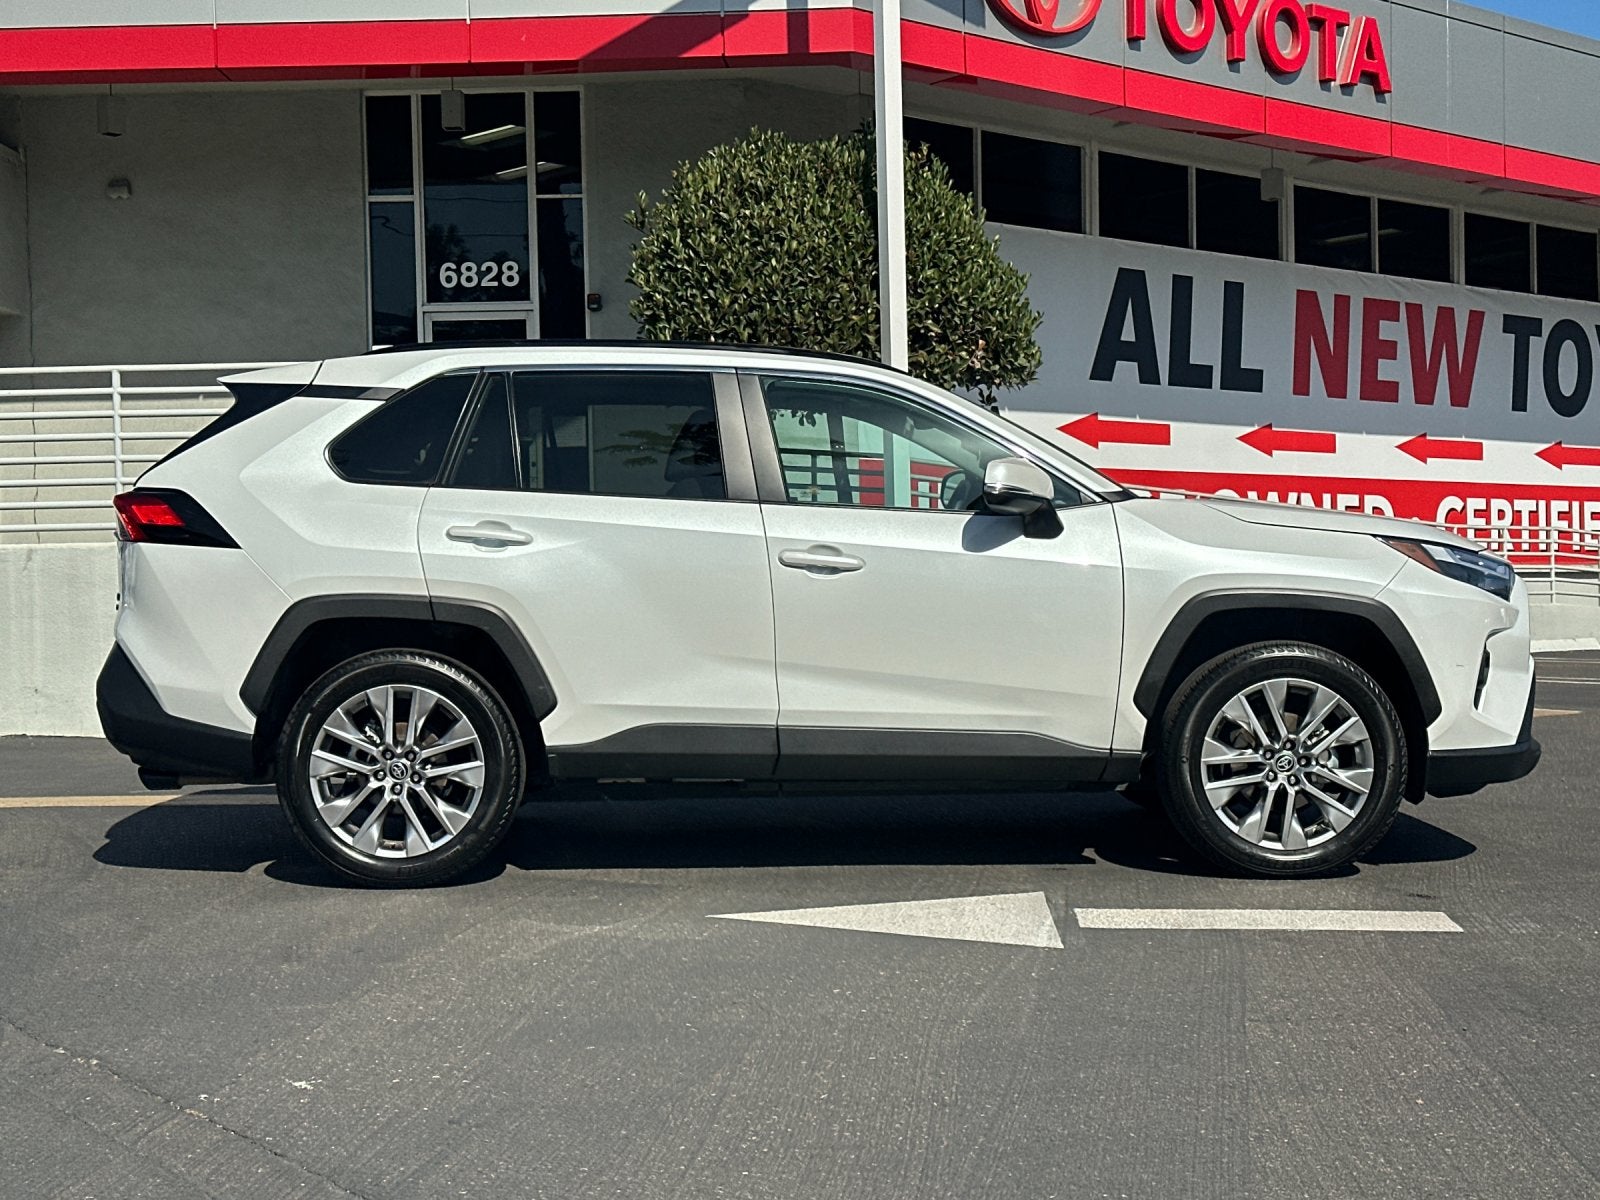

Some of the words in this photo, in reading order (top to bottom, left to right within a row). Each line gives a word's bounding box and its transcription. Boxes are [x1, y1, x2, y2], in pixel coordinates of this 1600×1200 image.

[439, 261, 520, 288] 6828
[1089, 267, 1264, 393] ALL
[1293, 289, 1486, 408] NEW
[1503, 313, 1600, 418] TO
